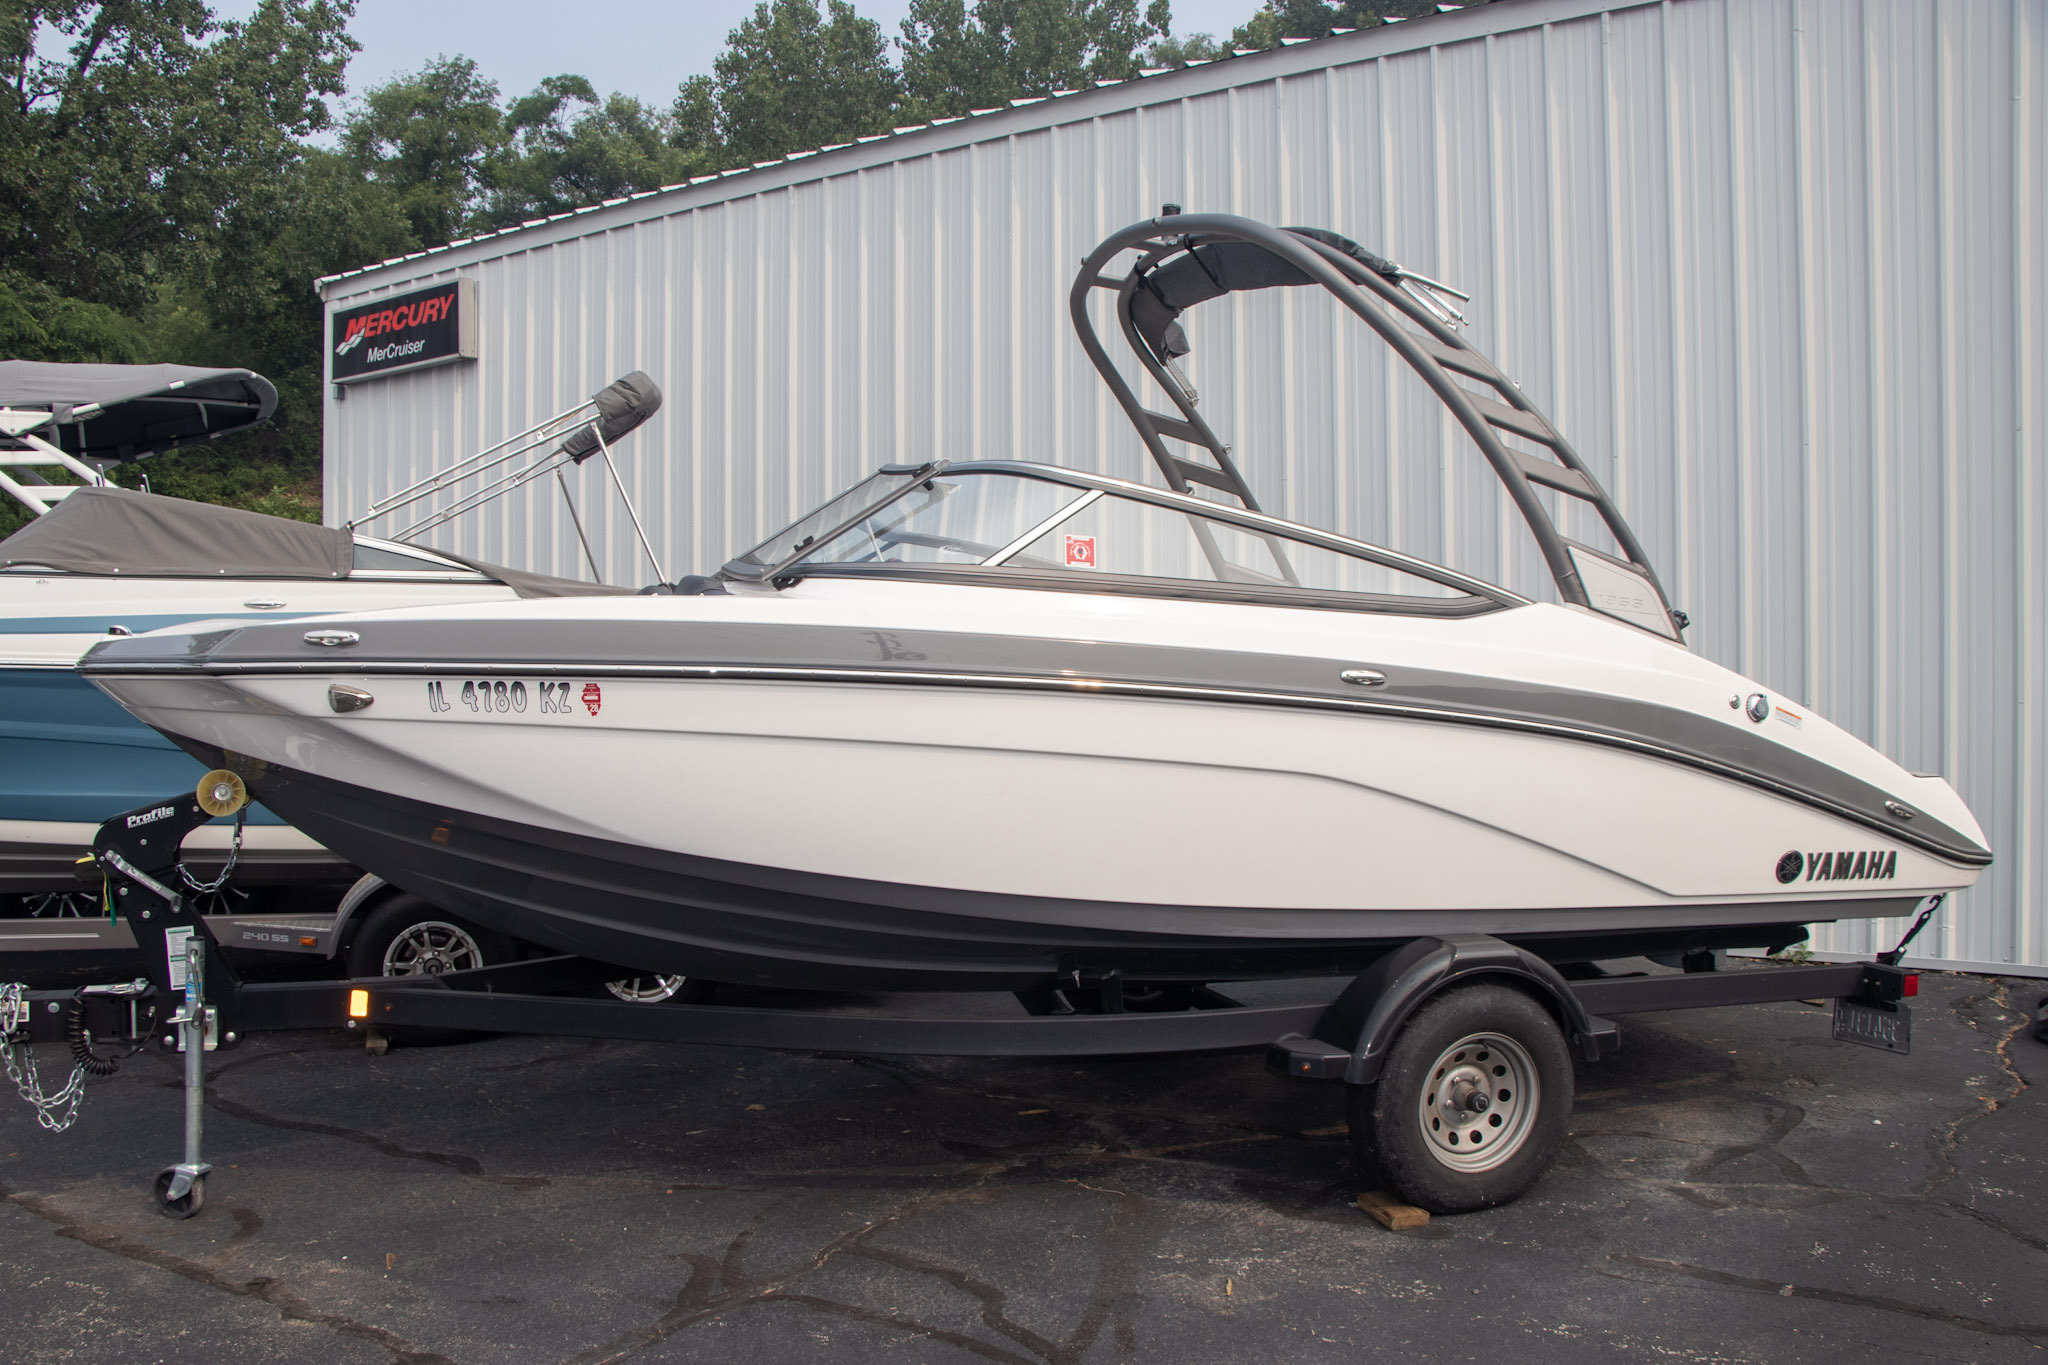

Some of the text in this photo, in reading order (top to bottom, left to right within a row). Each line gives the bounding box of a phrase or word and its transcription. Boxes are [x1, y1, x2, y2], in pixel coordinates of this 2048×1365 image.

[344, 293, 455, 342] MERCURY
[366, 339, 426, 363] MerCruiser
[427, 680, 451, 713] IL
[461, 680, 528, 713] 4780
[539, 681, 572, 713] KZ
[127, 806, 175, 825] Profile
[1806, 850, 1898, 882] YAMAHA
[242, 931, 289, 943] 240 SS
